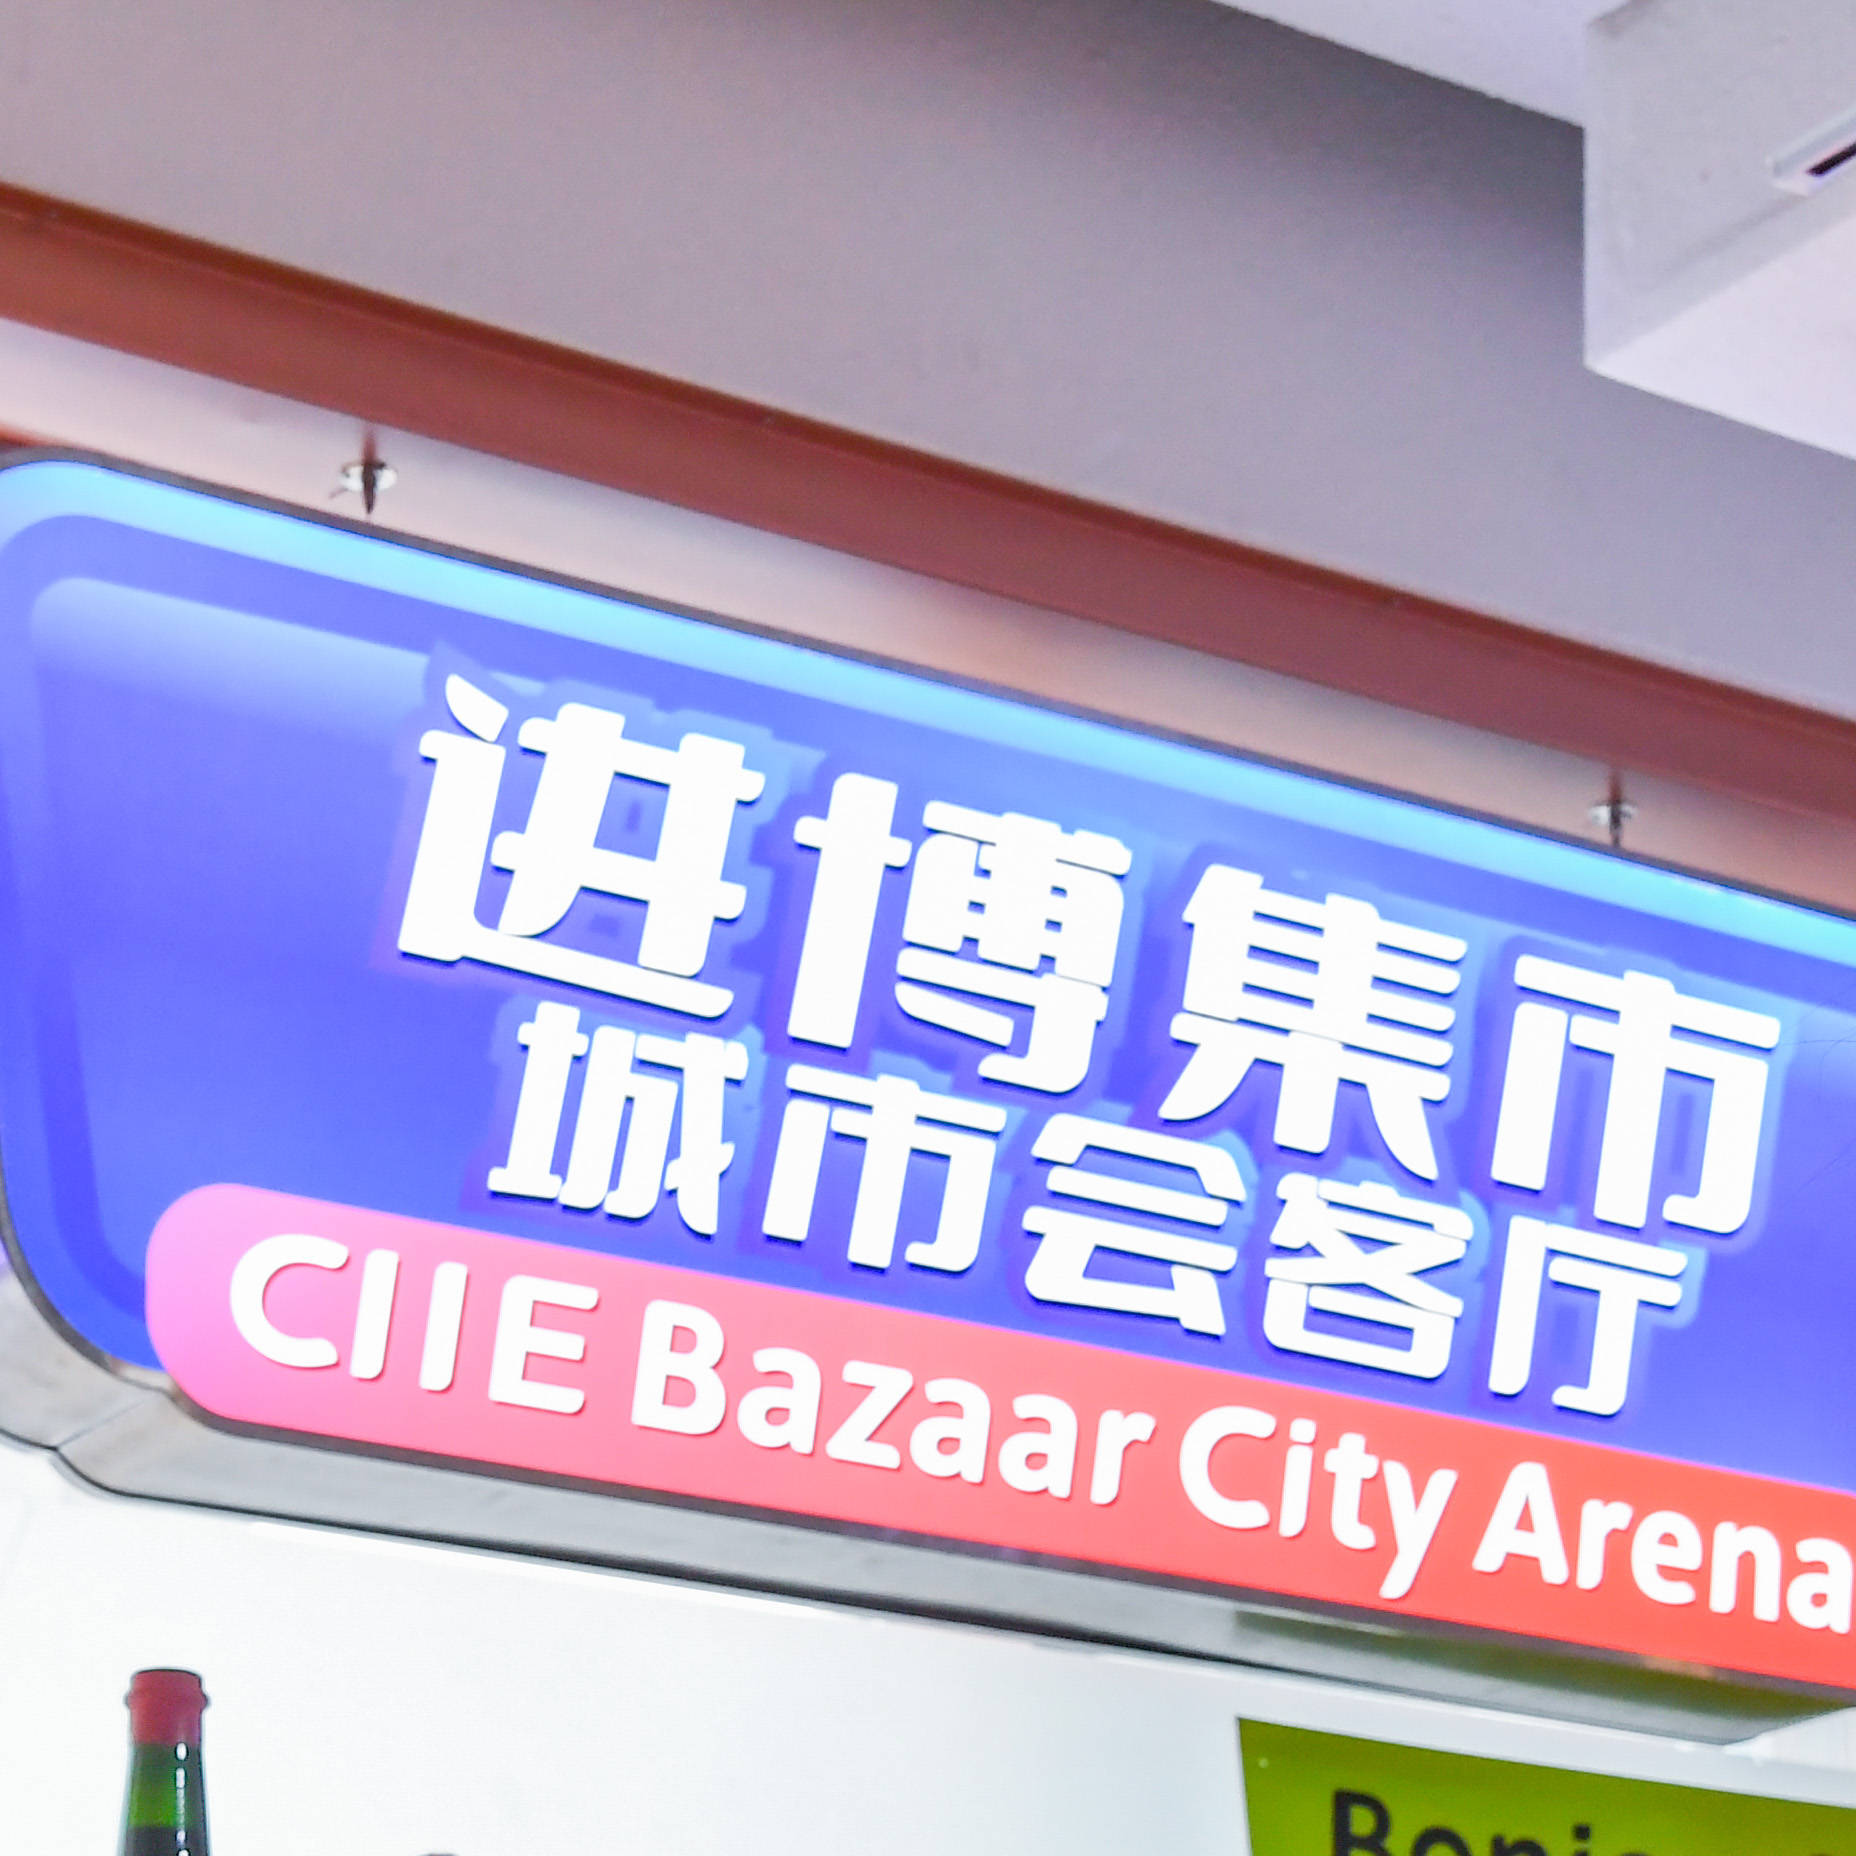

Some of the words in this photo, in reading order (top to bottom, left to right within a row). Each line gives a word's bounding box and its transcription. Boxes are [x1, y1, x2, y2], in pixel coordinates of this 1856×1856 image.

[396, 671, 1782, 1242] 进博集市
[490, 1002, 1690, 1417] 城市会客厅
[228, 1231, 600, 1414] CIIE
[634, 1301, 1155, 1509] Bazaar
[1179, 1404, 1460, 1600] City
[1472, 1460, 1855, 1637] Arena
